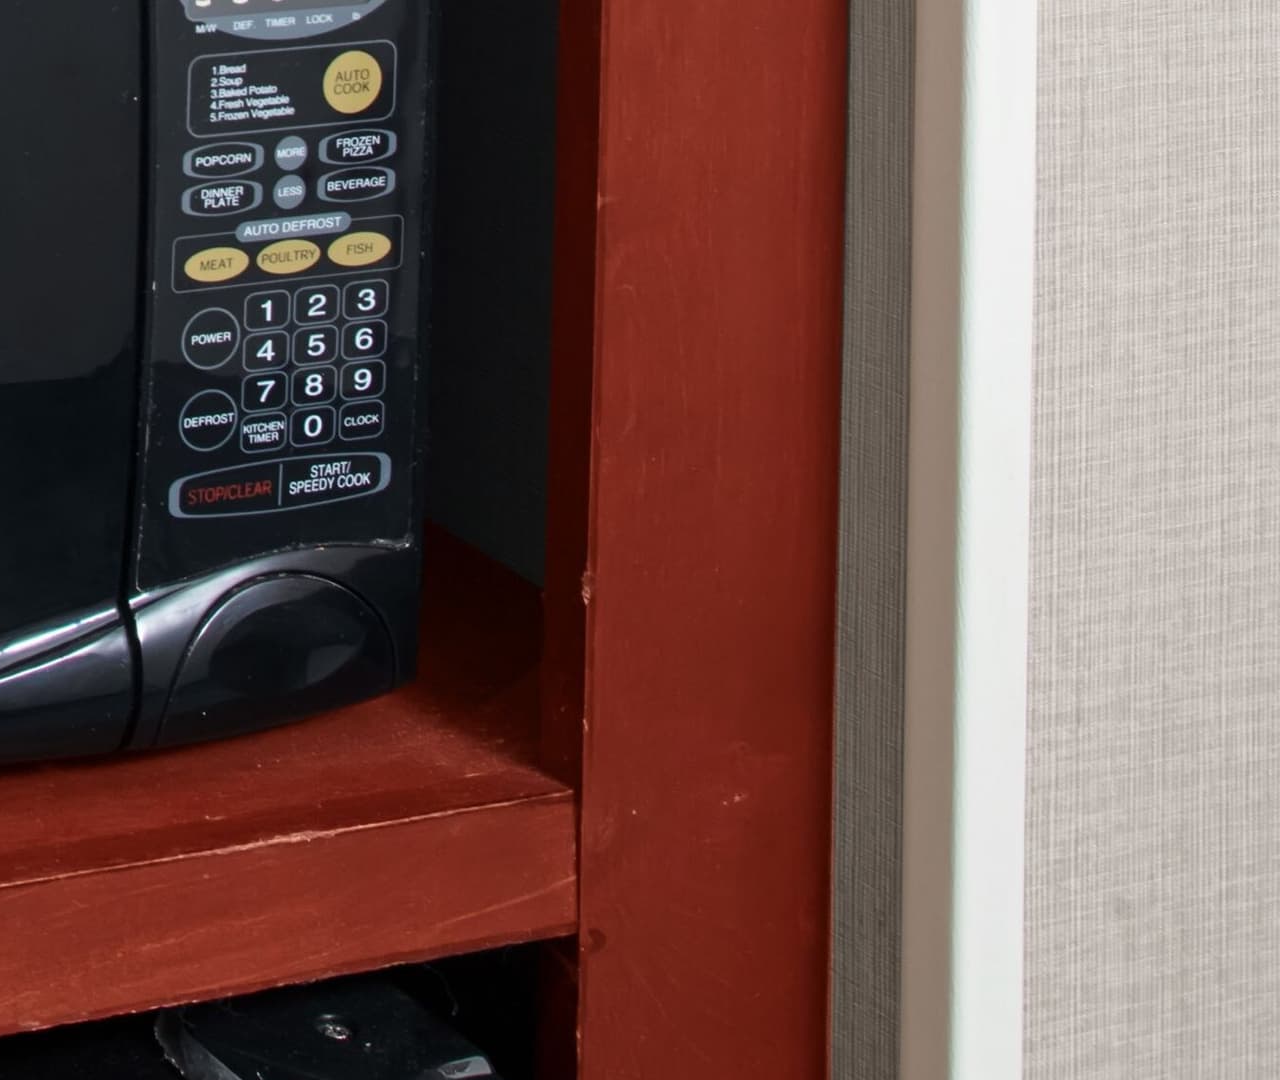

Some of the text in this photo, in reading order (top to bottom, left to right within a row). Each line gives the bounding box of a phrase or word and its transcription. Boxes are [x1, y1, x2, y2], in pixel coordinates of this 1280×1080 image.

[265, 16, 296, 28] TIMER
[306, 14, 333, 25] LOCK
[210, 77, 243, 88] 2.Soup
[335, 68, 370, 82] AUTO
[249, 85, 278, 96] Potato
[333, 82, 370, 95] COOK
[210, 95, 290, 110] 4.Fresh Vegetable
[209, 106, 295, 123] 5.Frozen Vegetable
[336, 135, 381, 149] FROZEN
[276, 147, 305, 159] MORE
[342, 147, 374, 158] PIZZA
[195, 153, 252, 168] POPCORN
[277, 185, 303, 198] LESS
[327, 176, 386, 192] BEVERAGE
[200, 186, 244, 200] DINNER
[204, 198, 240, 209] PLATE
[243, 216, 342, 237] AUTO DEFROST
[346, 242, 374, 256] FISH
[199, 257, 234, 272] MEAT
[260, 249, 317, 266] POULTRY
[307, 293, 327, 317] 2
[357, 288, 376, 311] 3
[260, 299, 273, 322] 1
[191, 331, 232, 346] POWER
[306, 334, 326, 357] 5
[355, 327, 374, 350] 6
[256, 339, 276, 362] 4
[304, 374, 324, 397] 8
[353, 368, 373, 391] 9
[256, 380, 276, 403] 7
[183, 412, 235, 430] DEFROST
[243, 420, 285, 436] KITCHEN
[303, 415, 323, 438] 0
[344, 414, 380, 428] CLOCK
[248, 432, 280, 445] TIMER
[310, 461, 352, 479] START/
[289, 472, 371, 496] SPEEDY COOK
[187, 480, 273, 506] STOP/CLEAR
